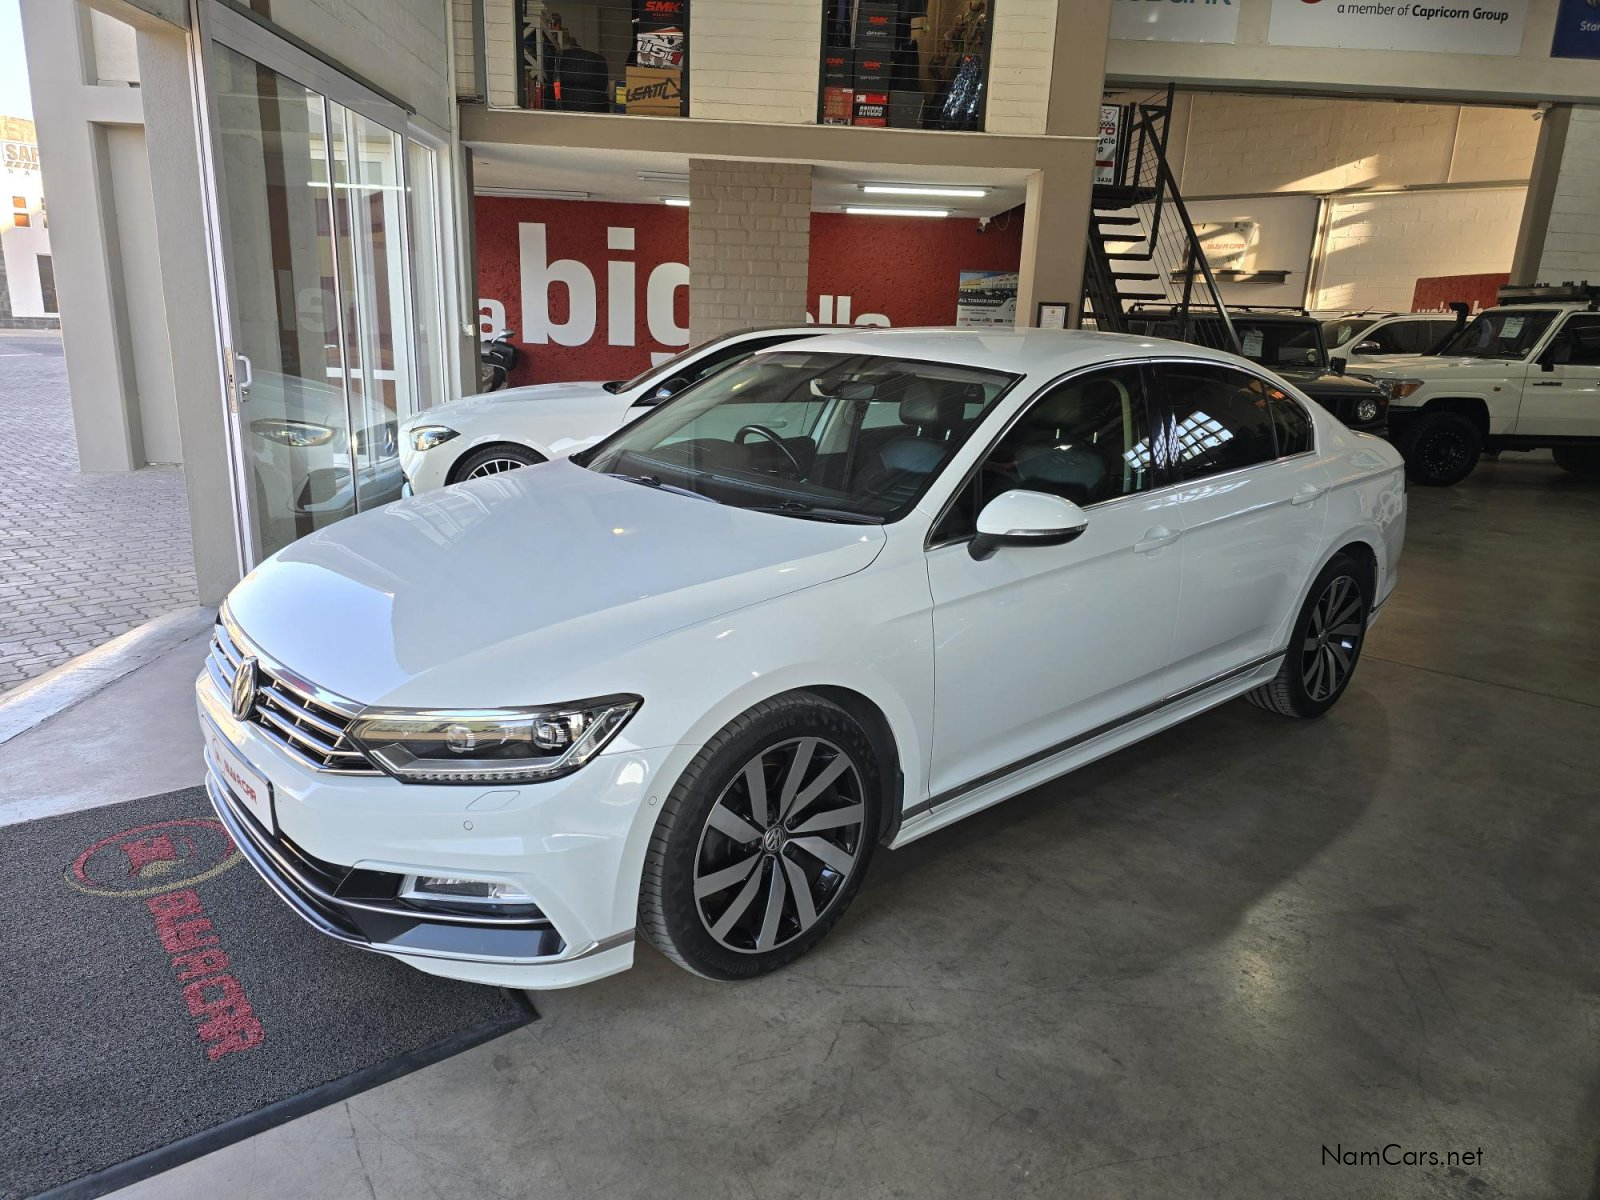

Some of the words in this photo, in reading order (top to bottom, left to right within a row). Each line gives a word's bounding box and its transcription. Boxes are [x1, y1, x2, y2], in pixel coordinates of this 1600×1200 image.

[645, 2, 680, 12] SMK
[1337, 4, 1345, 13] a
[1347, 3, 1396, 15] member
[1397, 4, 1411, 16] of
[1412, 5, 1470, 20] Capricorn
[1472, 7, 1509, 24] Group
